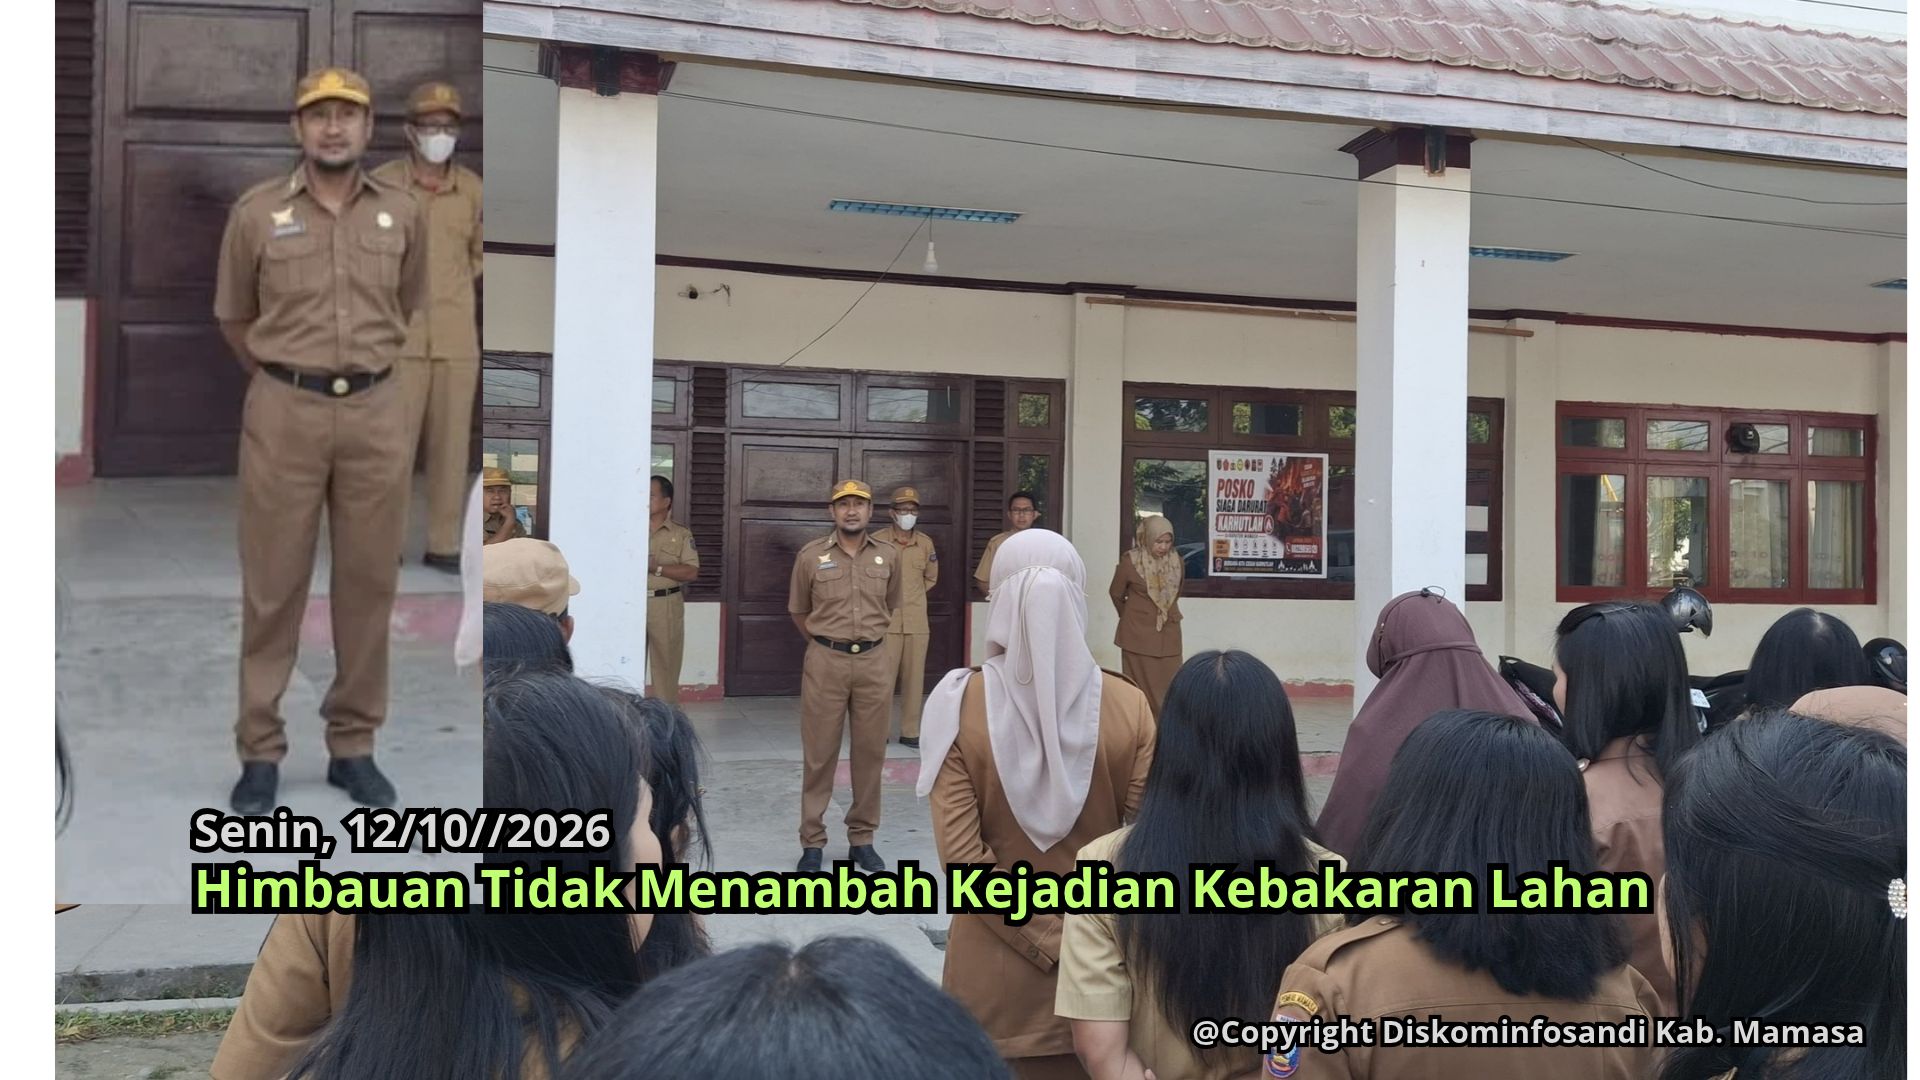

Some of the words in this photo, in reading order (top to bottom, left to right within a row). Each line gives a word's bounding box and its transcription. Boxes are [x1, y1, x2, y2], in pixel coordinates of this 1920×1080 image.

[1216, 479, 1255, 499] POSKO
[1216, 499, 1236, 513] SIAGA
[1237, 500, 1268, 514] DARURAT
[1217, 515, 1264, 532] KARHUTLAH
